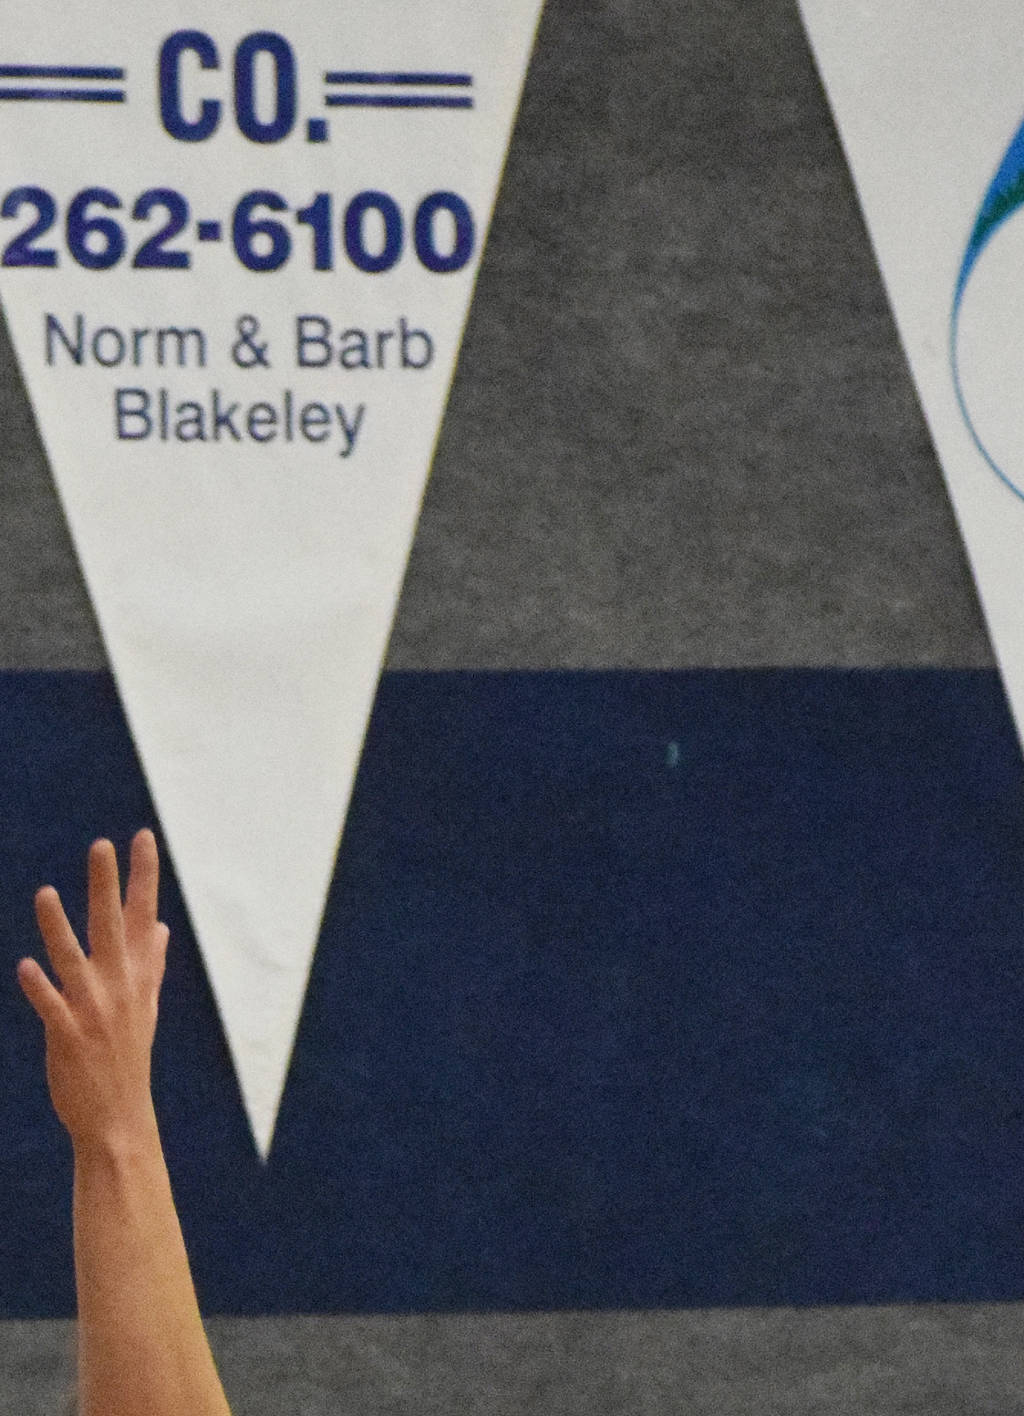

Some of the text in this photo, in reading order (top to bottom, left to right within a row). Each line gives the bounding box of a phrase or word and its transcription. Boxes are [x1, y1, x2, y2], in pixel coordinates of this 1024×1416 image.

[157, 29, 328, 144] CO.
[0, 186, 475, 274] 262-6100
[44, 313, 435, 370] Norm & Barb
[115, 388, 366, 458] Blakeley
